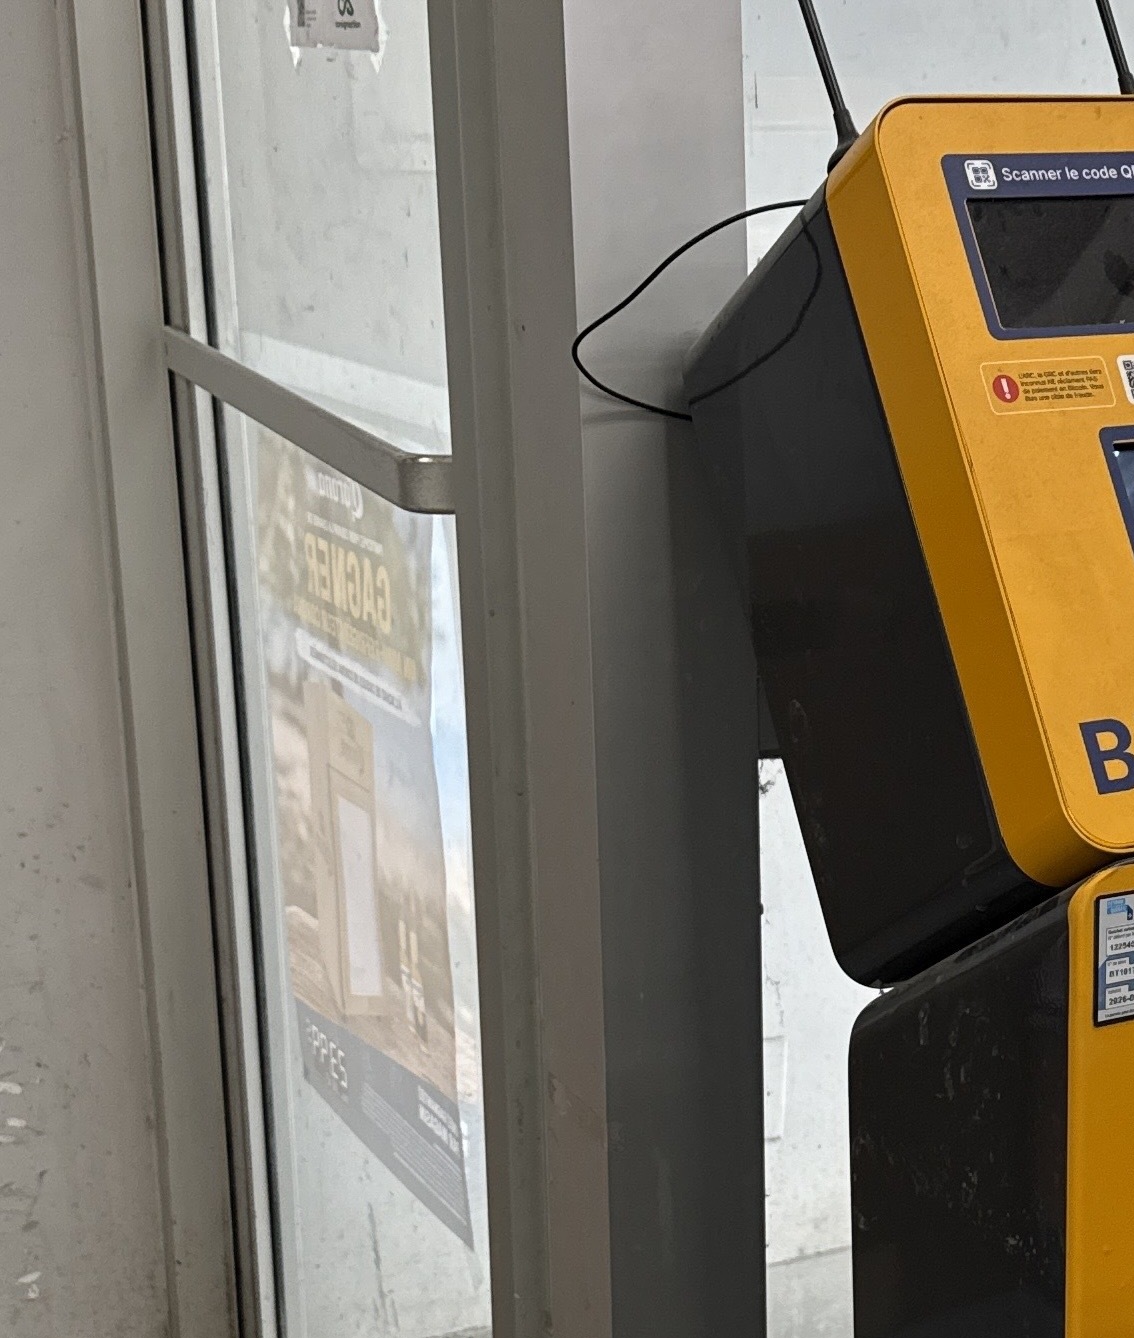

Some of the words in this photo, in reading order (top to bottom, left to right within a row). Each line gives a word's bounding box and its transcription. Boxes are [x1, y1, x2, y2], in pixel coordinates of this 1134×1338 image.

[1002, 167, 1062, 182] Scanner
[1065, 166, 1079, 180] le
[1082, 165, 1118, 180] code
